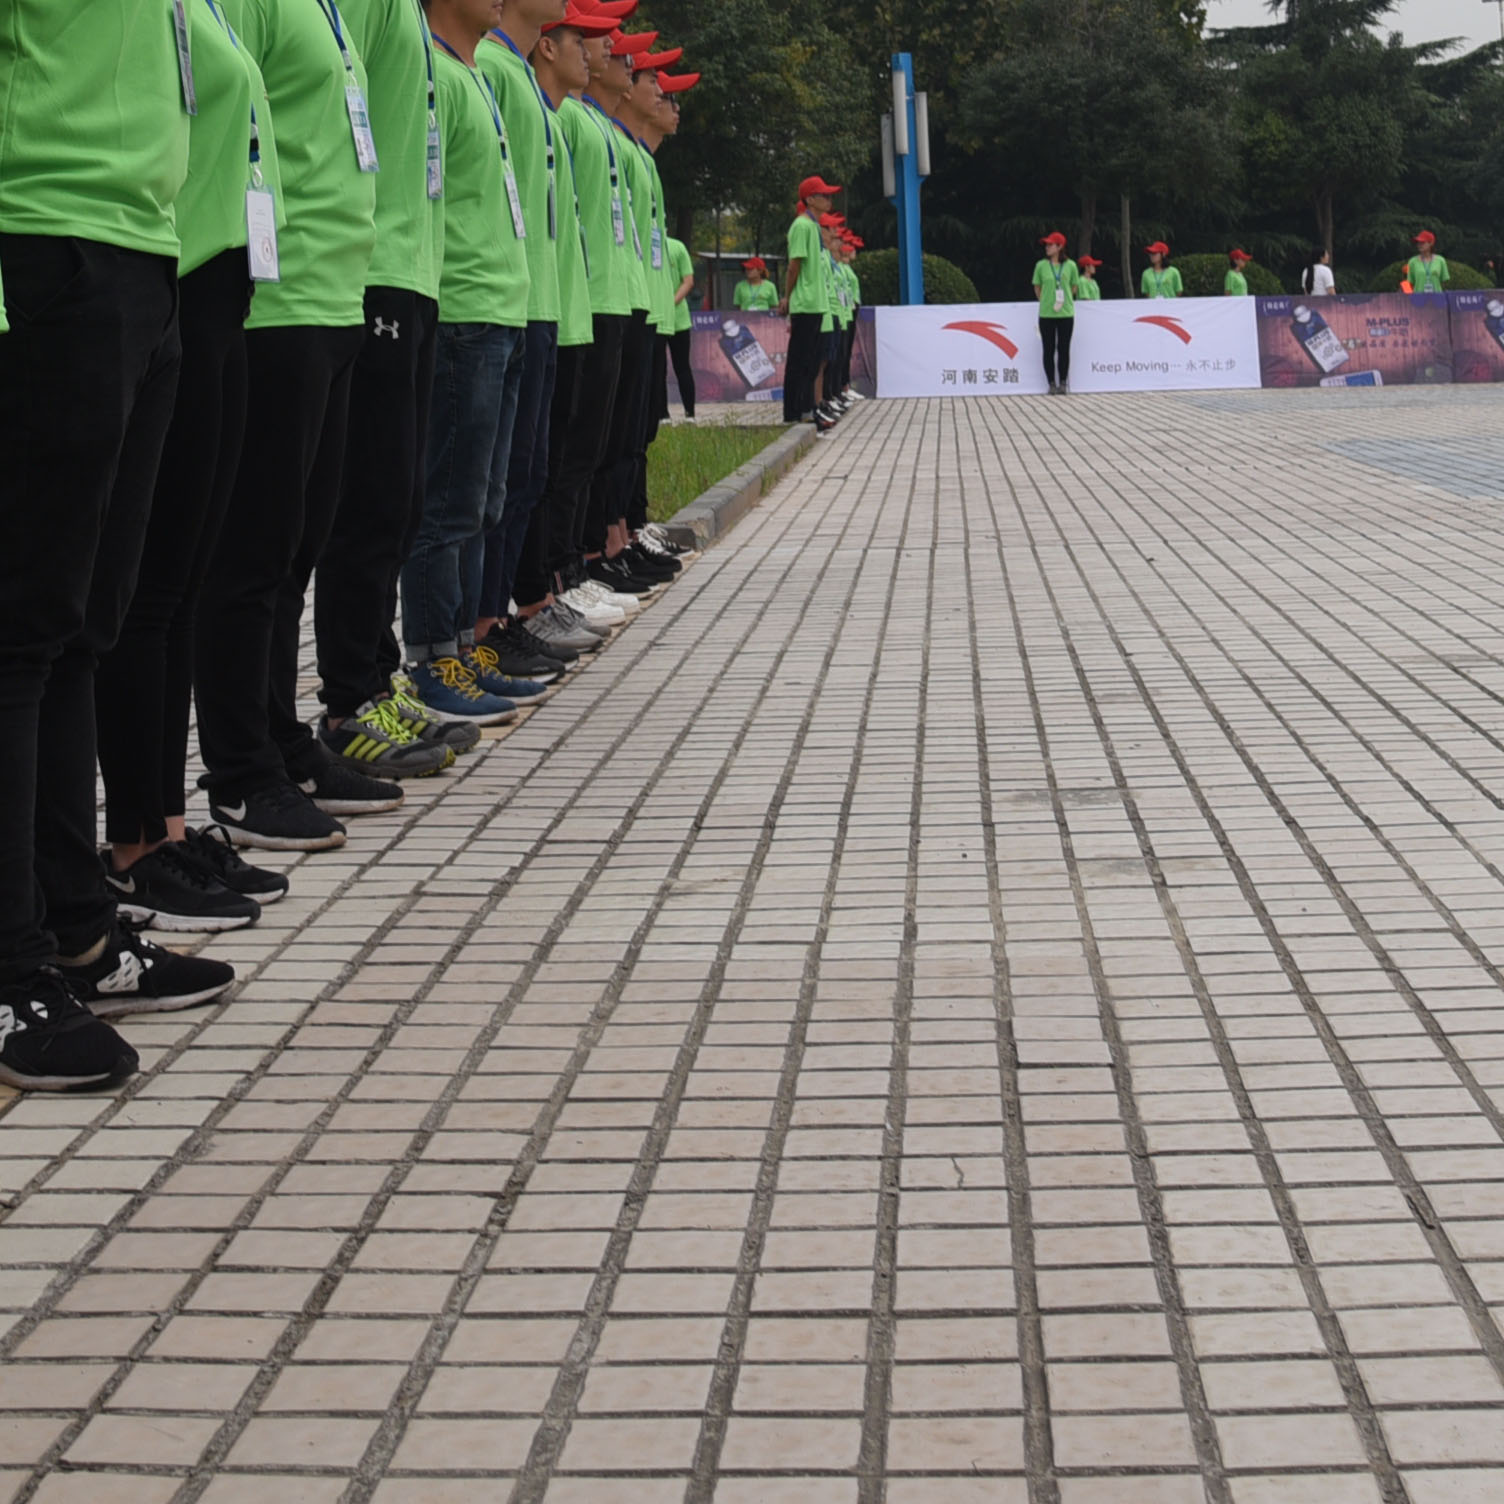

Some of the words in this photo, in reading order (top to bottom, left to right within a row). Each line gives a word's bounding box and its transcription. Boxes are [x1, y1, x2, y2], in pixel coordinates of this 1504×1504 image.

[1091, 361, 1122, 374] Keep
[1186, 357, 1237, 371] 永不止步
[942, 368, 1020, 385] 河南安踏
